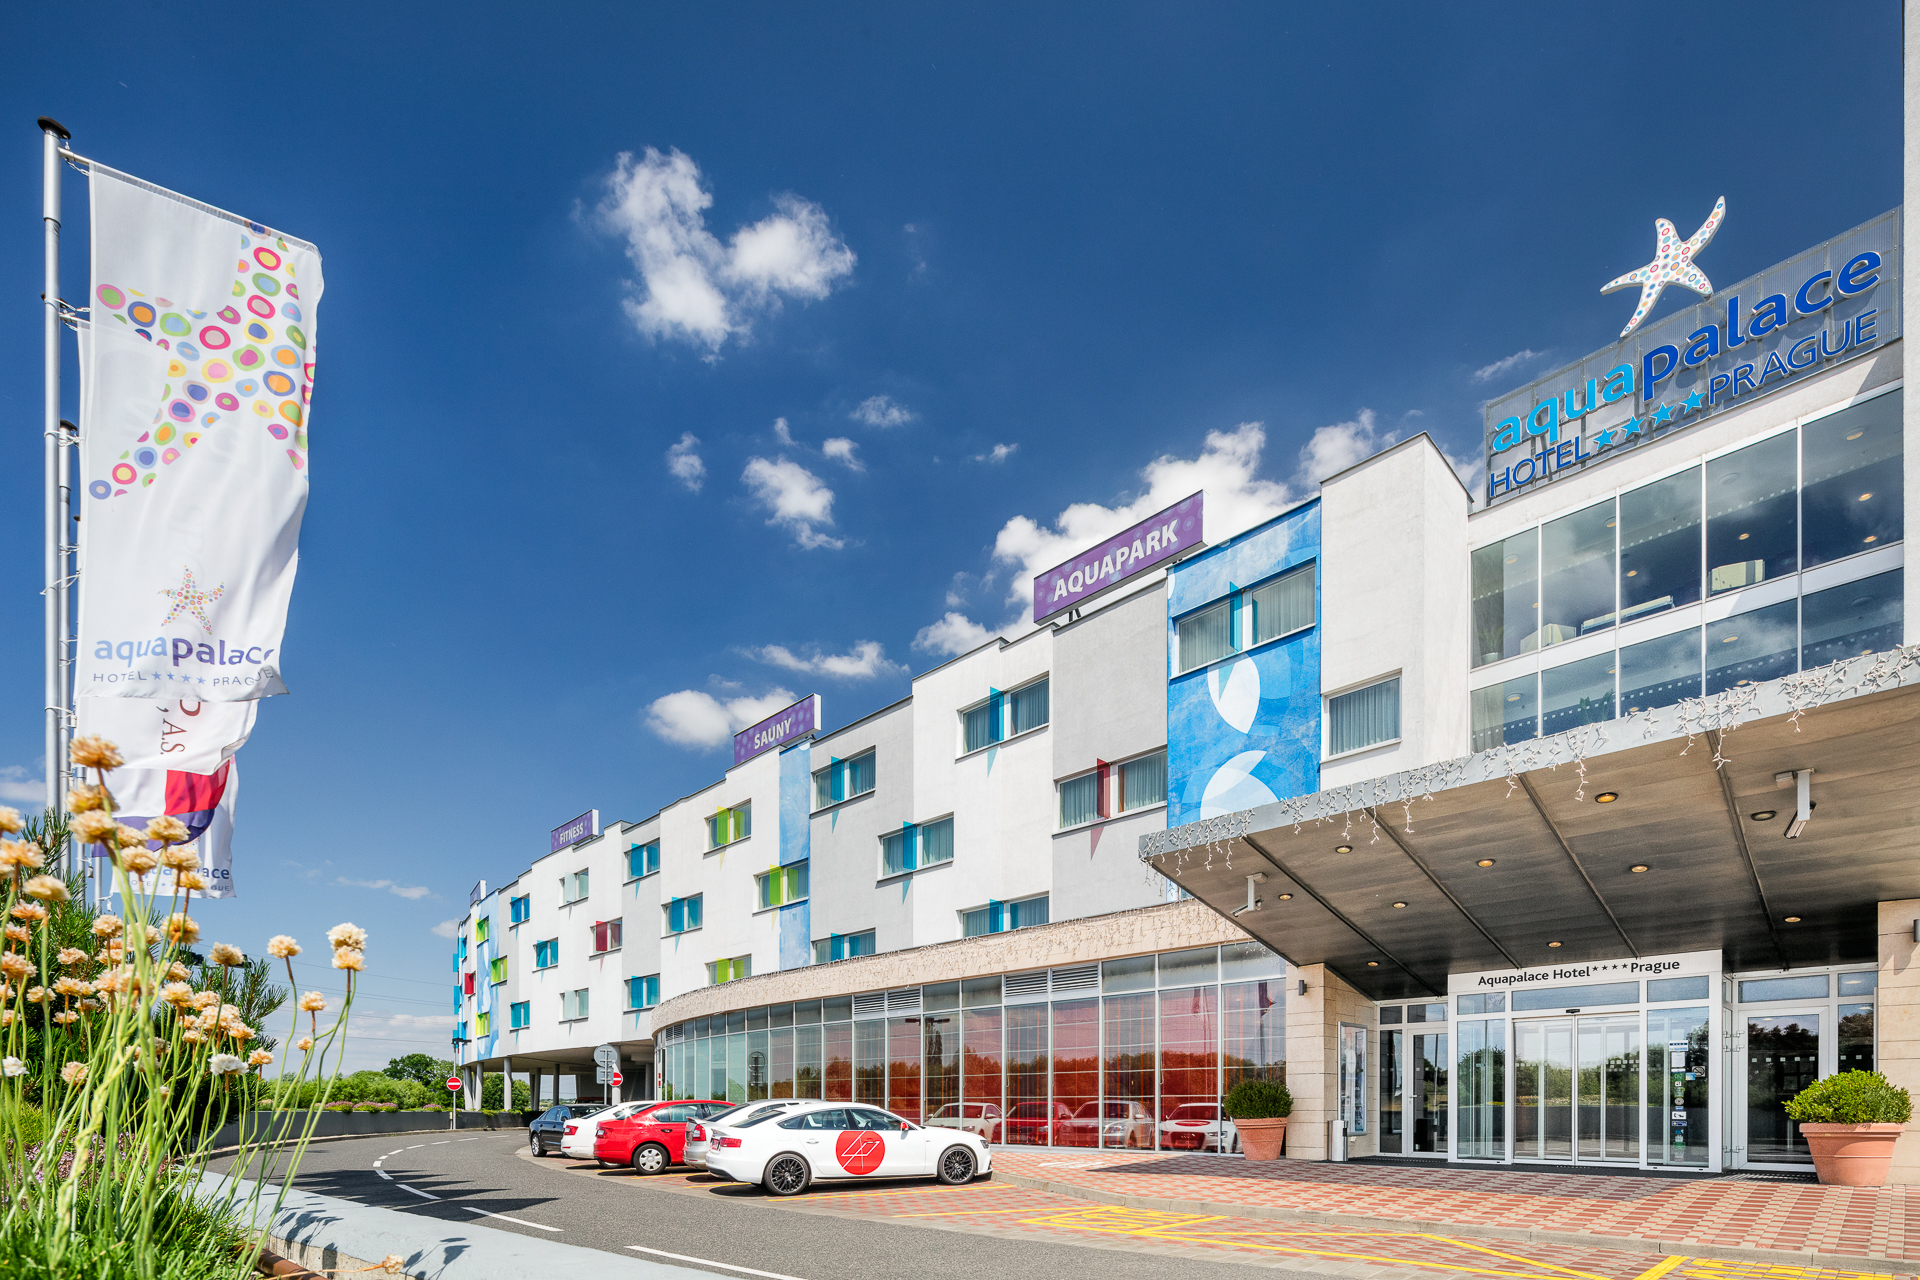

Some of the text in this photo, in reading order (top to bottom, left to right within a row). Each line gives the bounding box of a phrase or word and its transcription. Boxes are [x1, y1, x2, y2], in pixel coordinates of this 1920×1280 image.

[1493, 250, 1883, 453] aquapalace
[1489, 308, 1878, 498] HOTEL PRAGUE
[1053, 519, 1179, 602] AQUAPARK
[93, 671, 147, 683] HOTEL
[754, 717, 792, 750] SAUNY
[559, 822, 584, 845] FITNESS
[1478, 972, 1549, 988] Aquapalace
[1630, 961, 1680, 974] Prague
